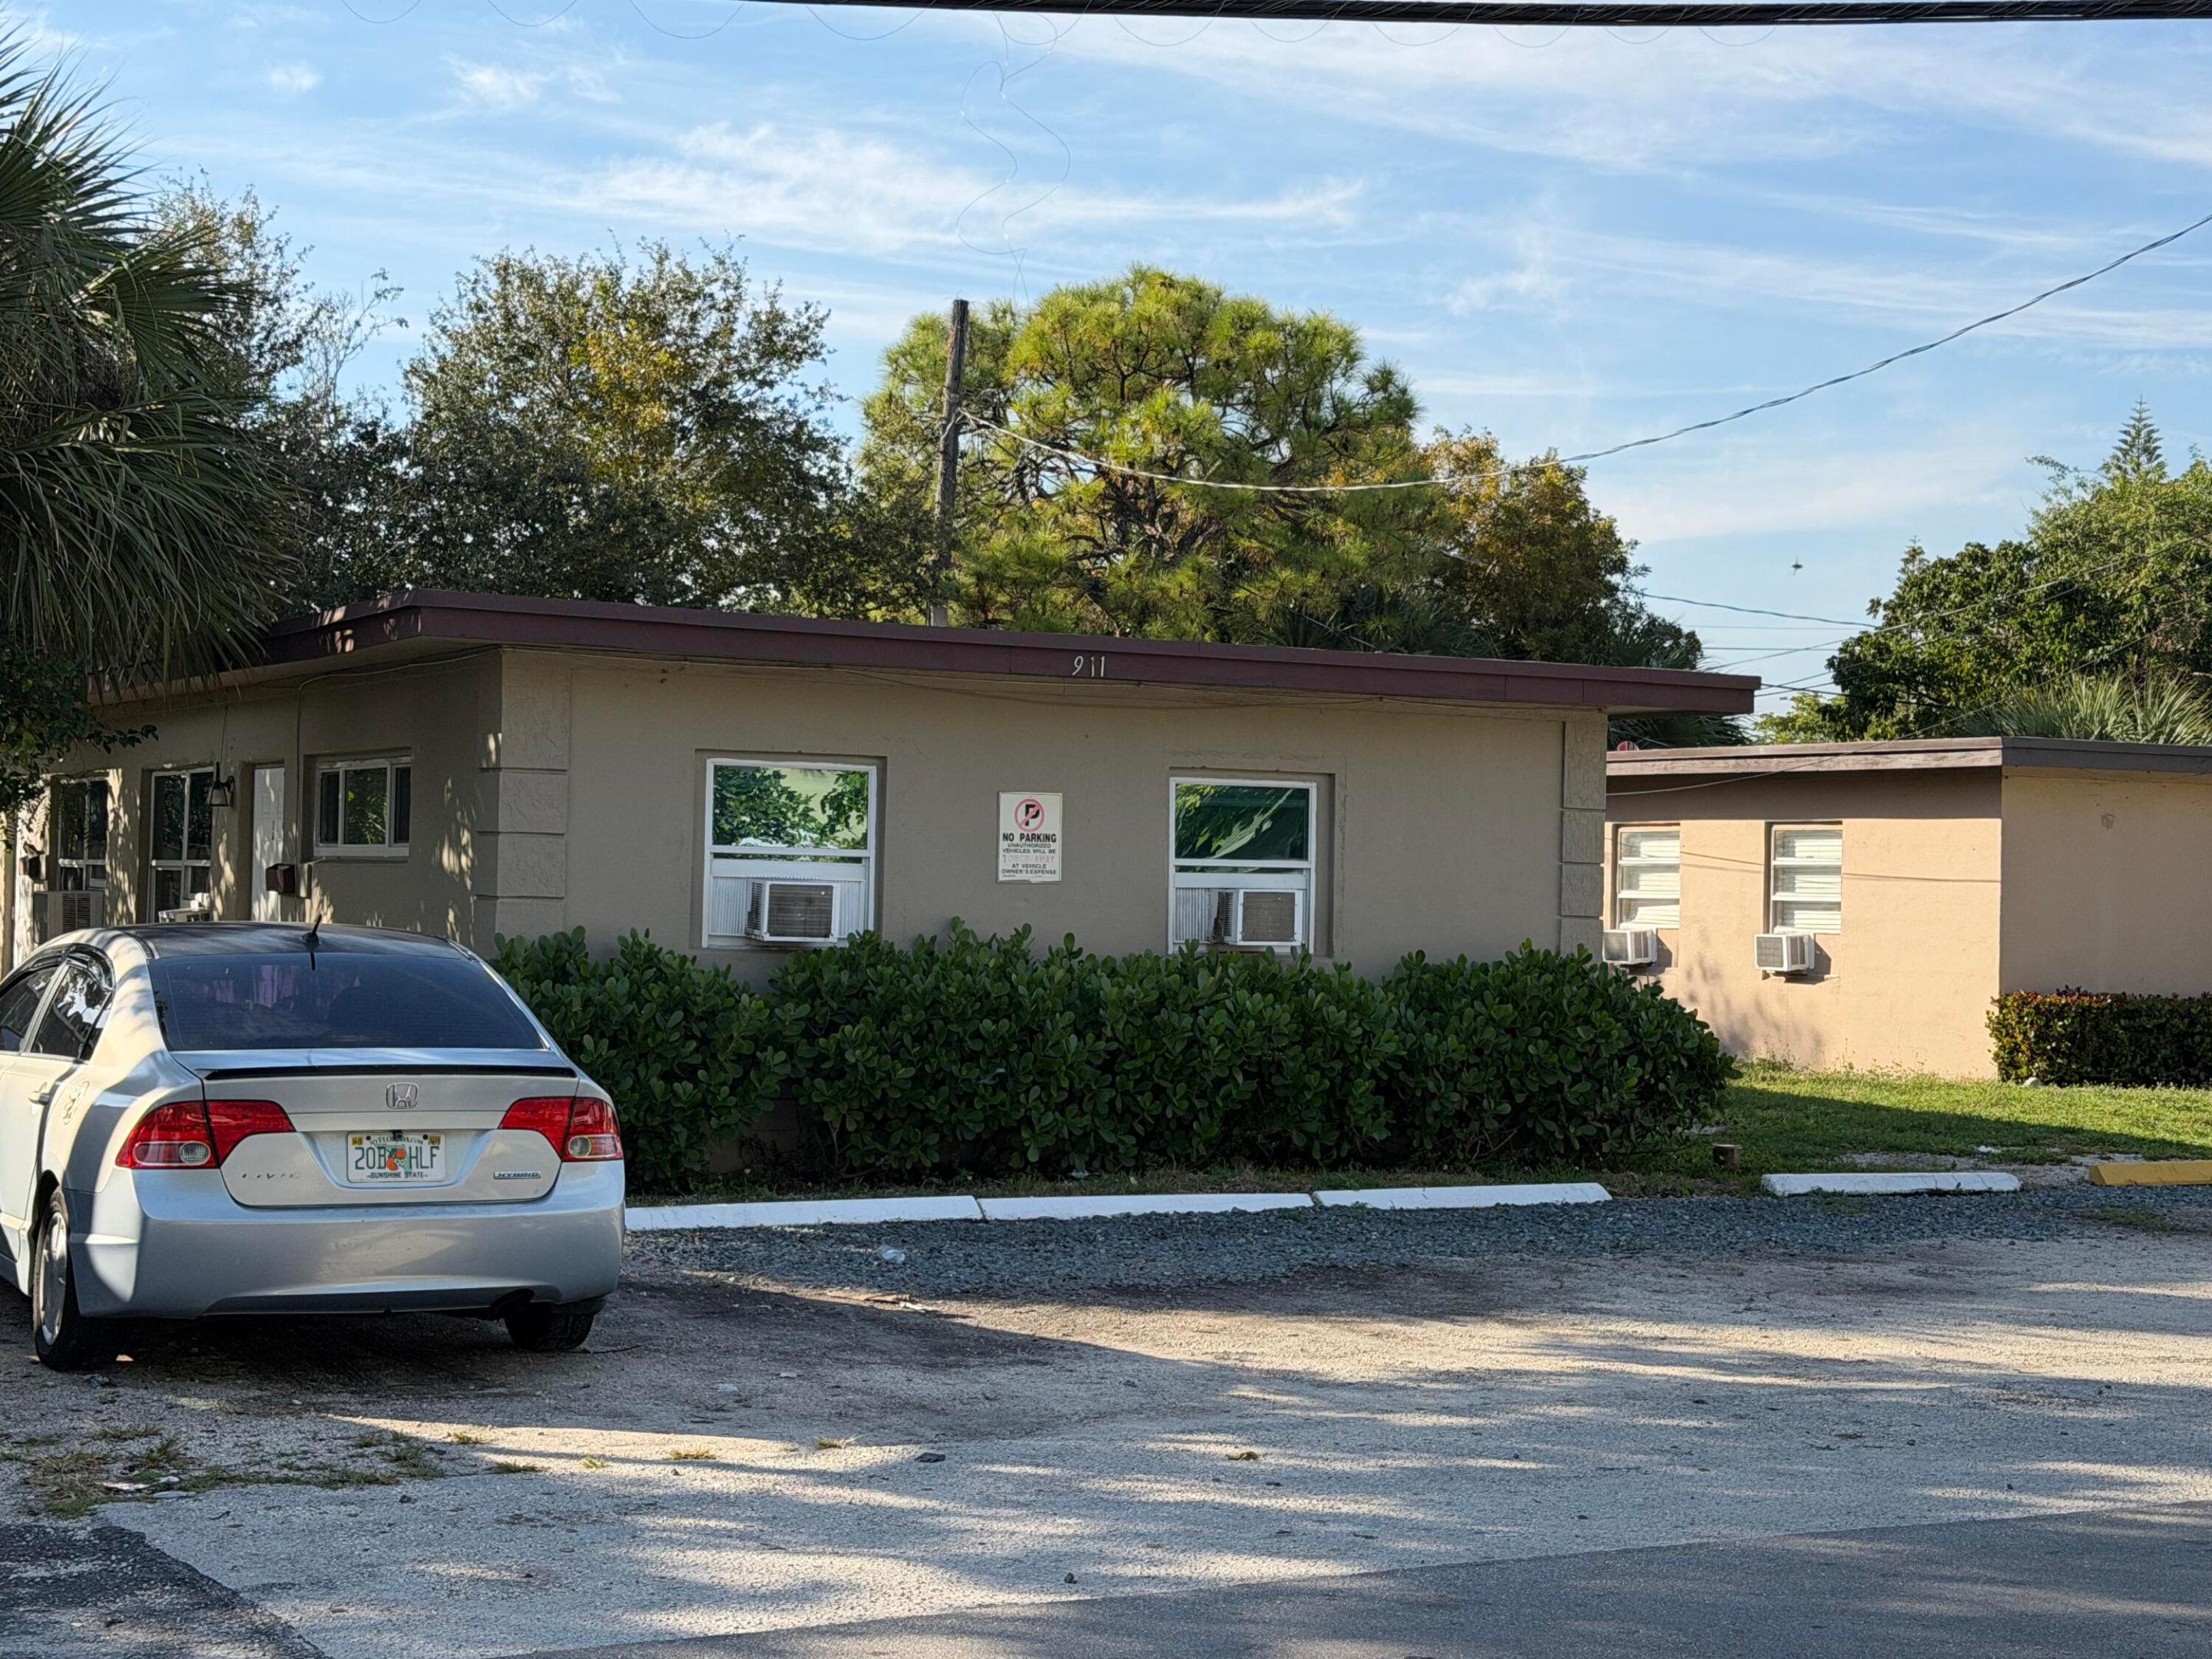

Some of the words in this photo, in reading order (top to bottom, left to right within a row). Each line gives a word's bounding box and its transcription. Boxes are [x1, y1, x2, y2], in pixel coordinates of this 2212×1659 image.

[1071, 655, 1105, 677] 911
[1002, 833, 1015, 842] NO
[1019, 833, 1057, 843] PARKING
[355, 1146, 386, 1170] 20B
[409, 1145, 440, 1169] HLF
